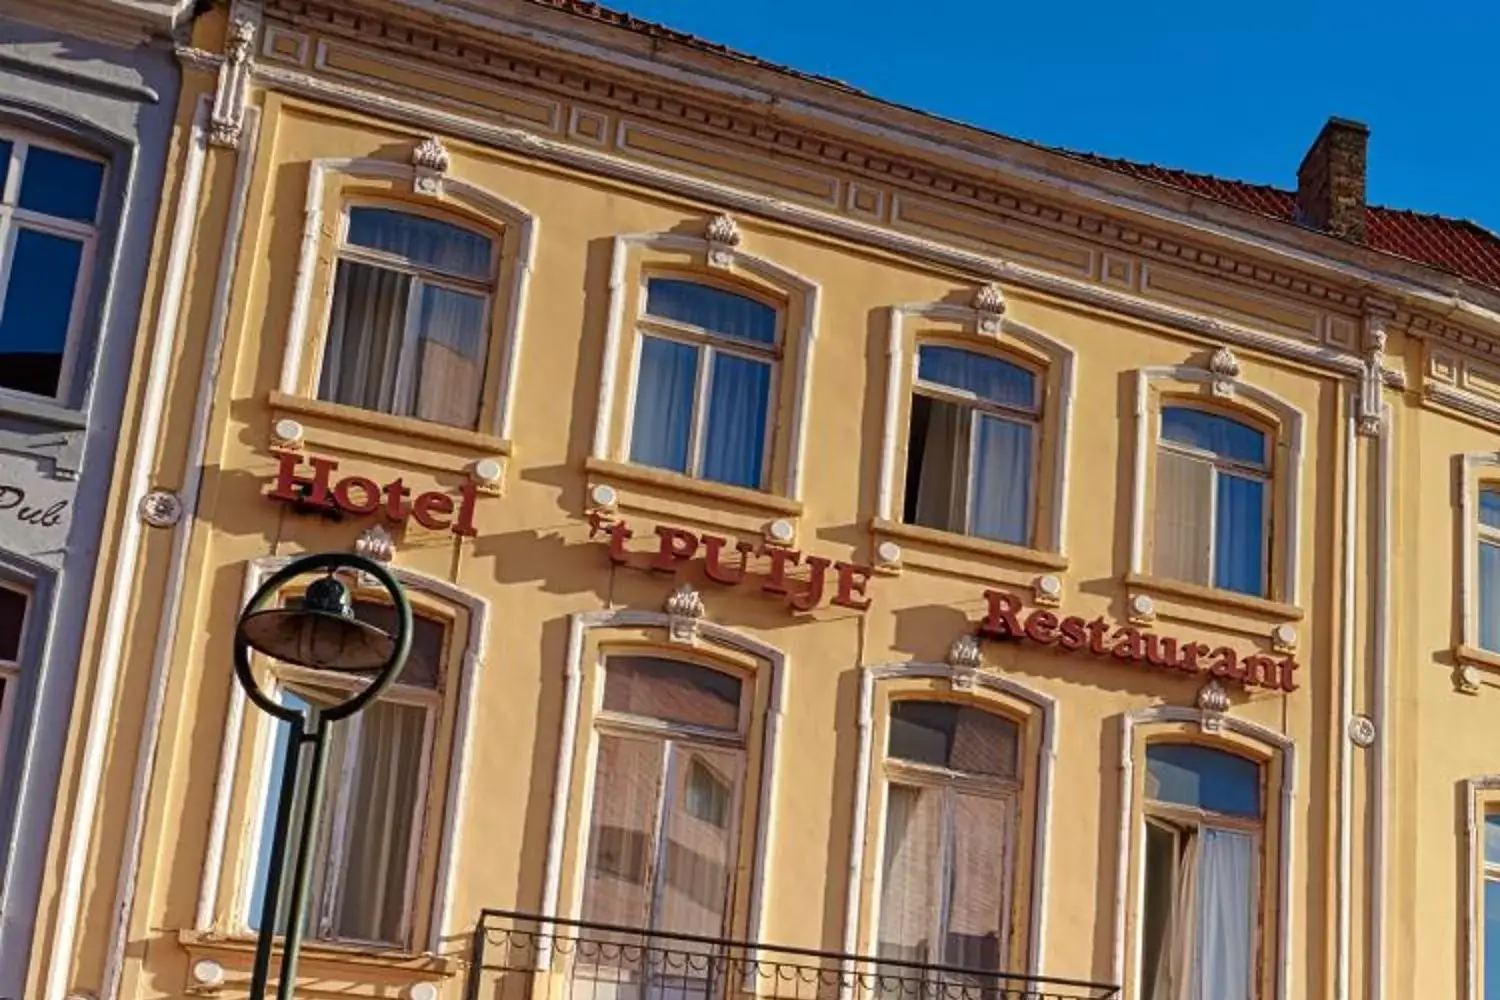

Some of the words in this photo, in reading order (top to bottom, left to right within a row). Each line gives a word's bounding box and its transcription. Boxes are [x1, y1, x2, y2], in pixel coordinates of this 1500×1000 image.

[268, 451, 482, 538] Hotel
[655, 524, 876, 612] PUTJE
[982, 589, 1300, 693] Restaurant
